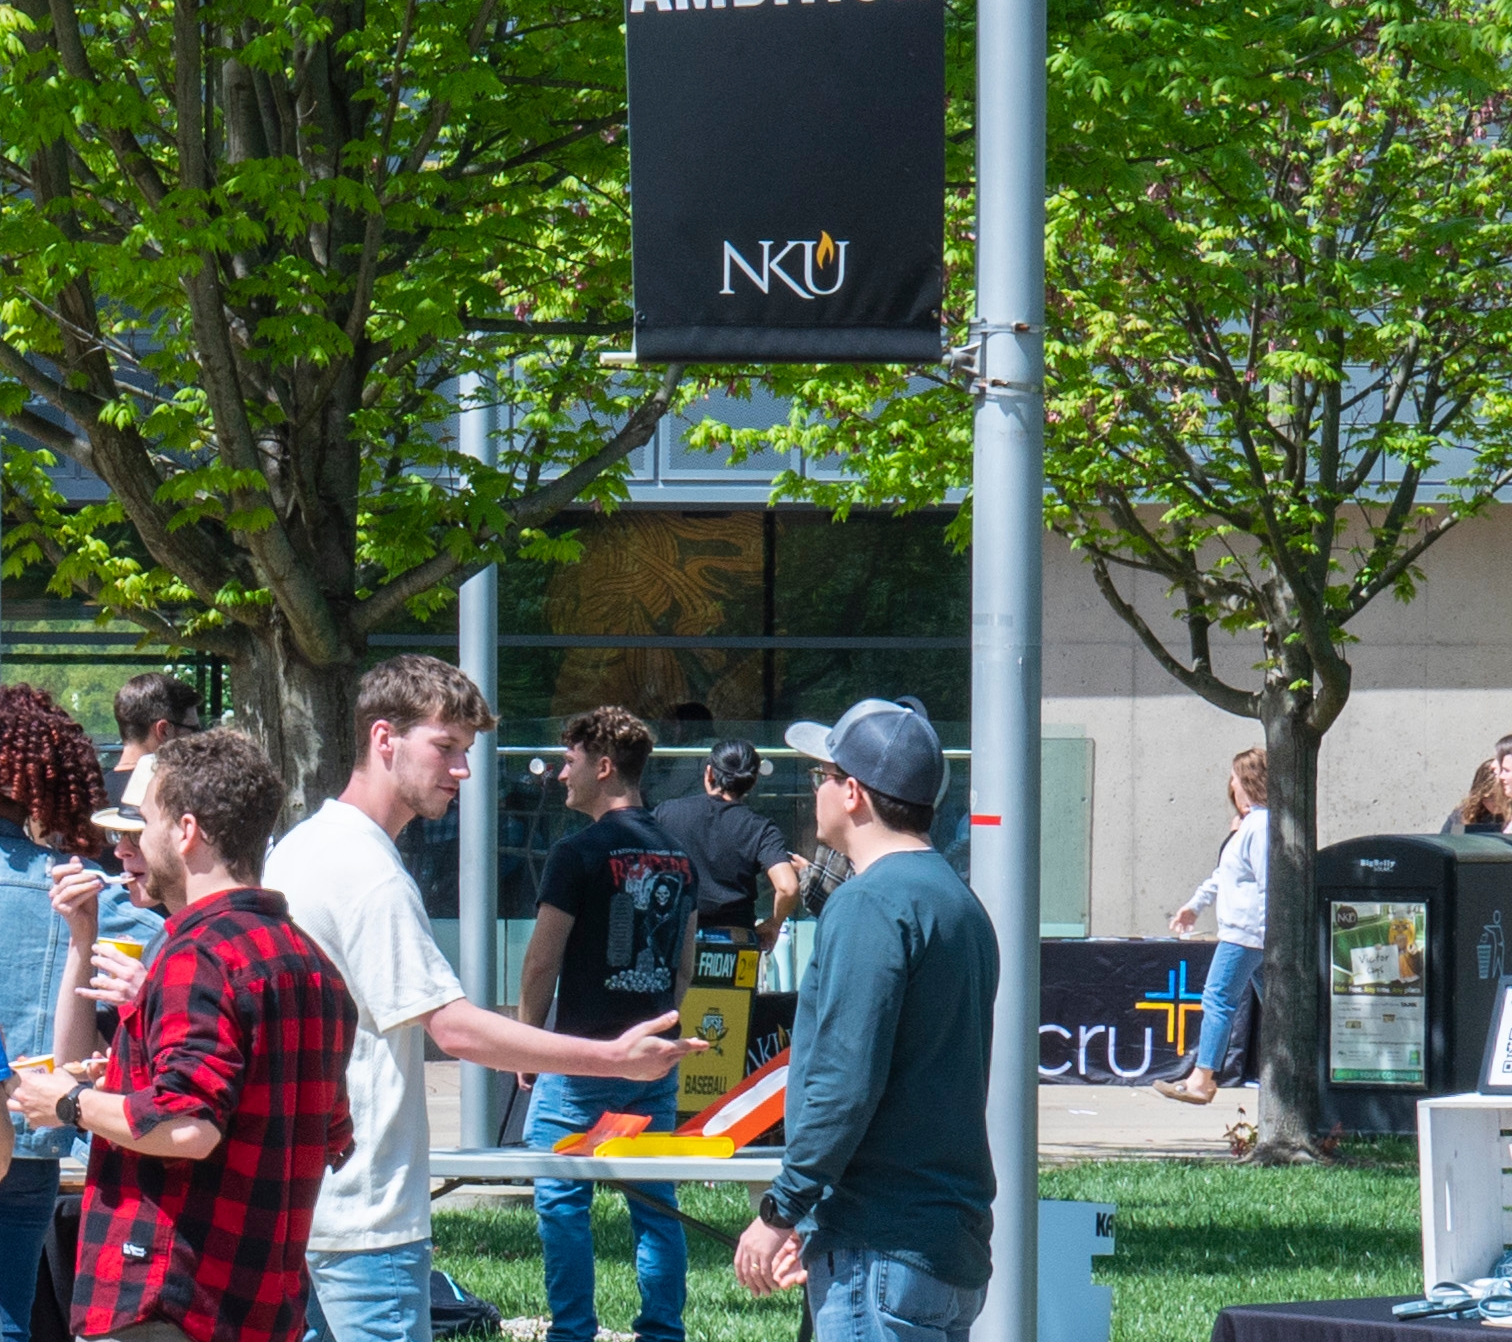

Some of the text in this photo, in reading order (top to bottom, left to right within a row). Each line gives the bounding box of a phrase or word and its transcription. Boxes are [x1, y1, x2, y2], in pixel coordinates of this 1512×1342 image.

[719, 239, 850, 299] NKU
[697, 951, 737, 978] FRIDAY
[1038, 1024, 1153, 1078] cru
[684, 1074, 727, 1095] BASEBALL
